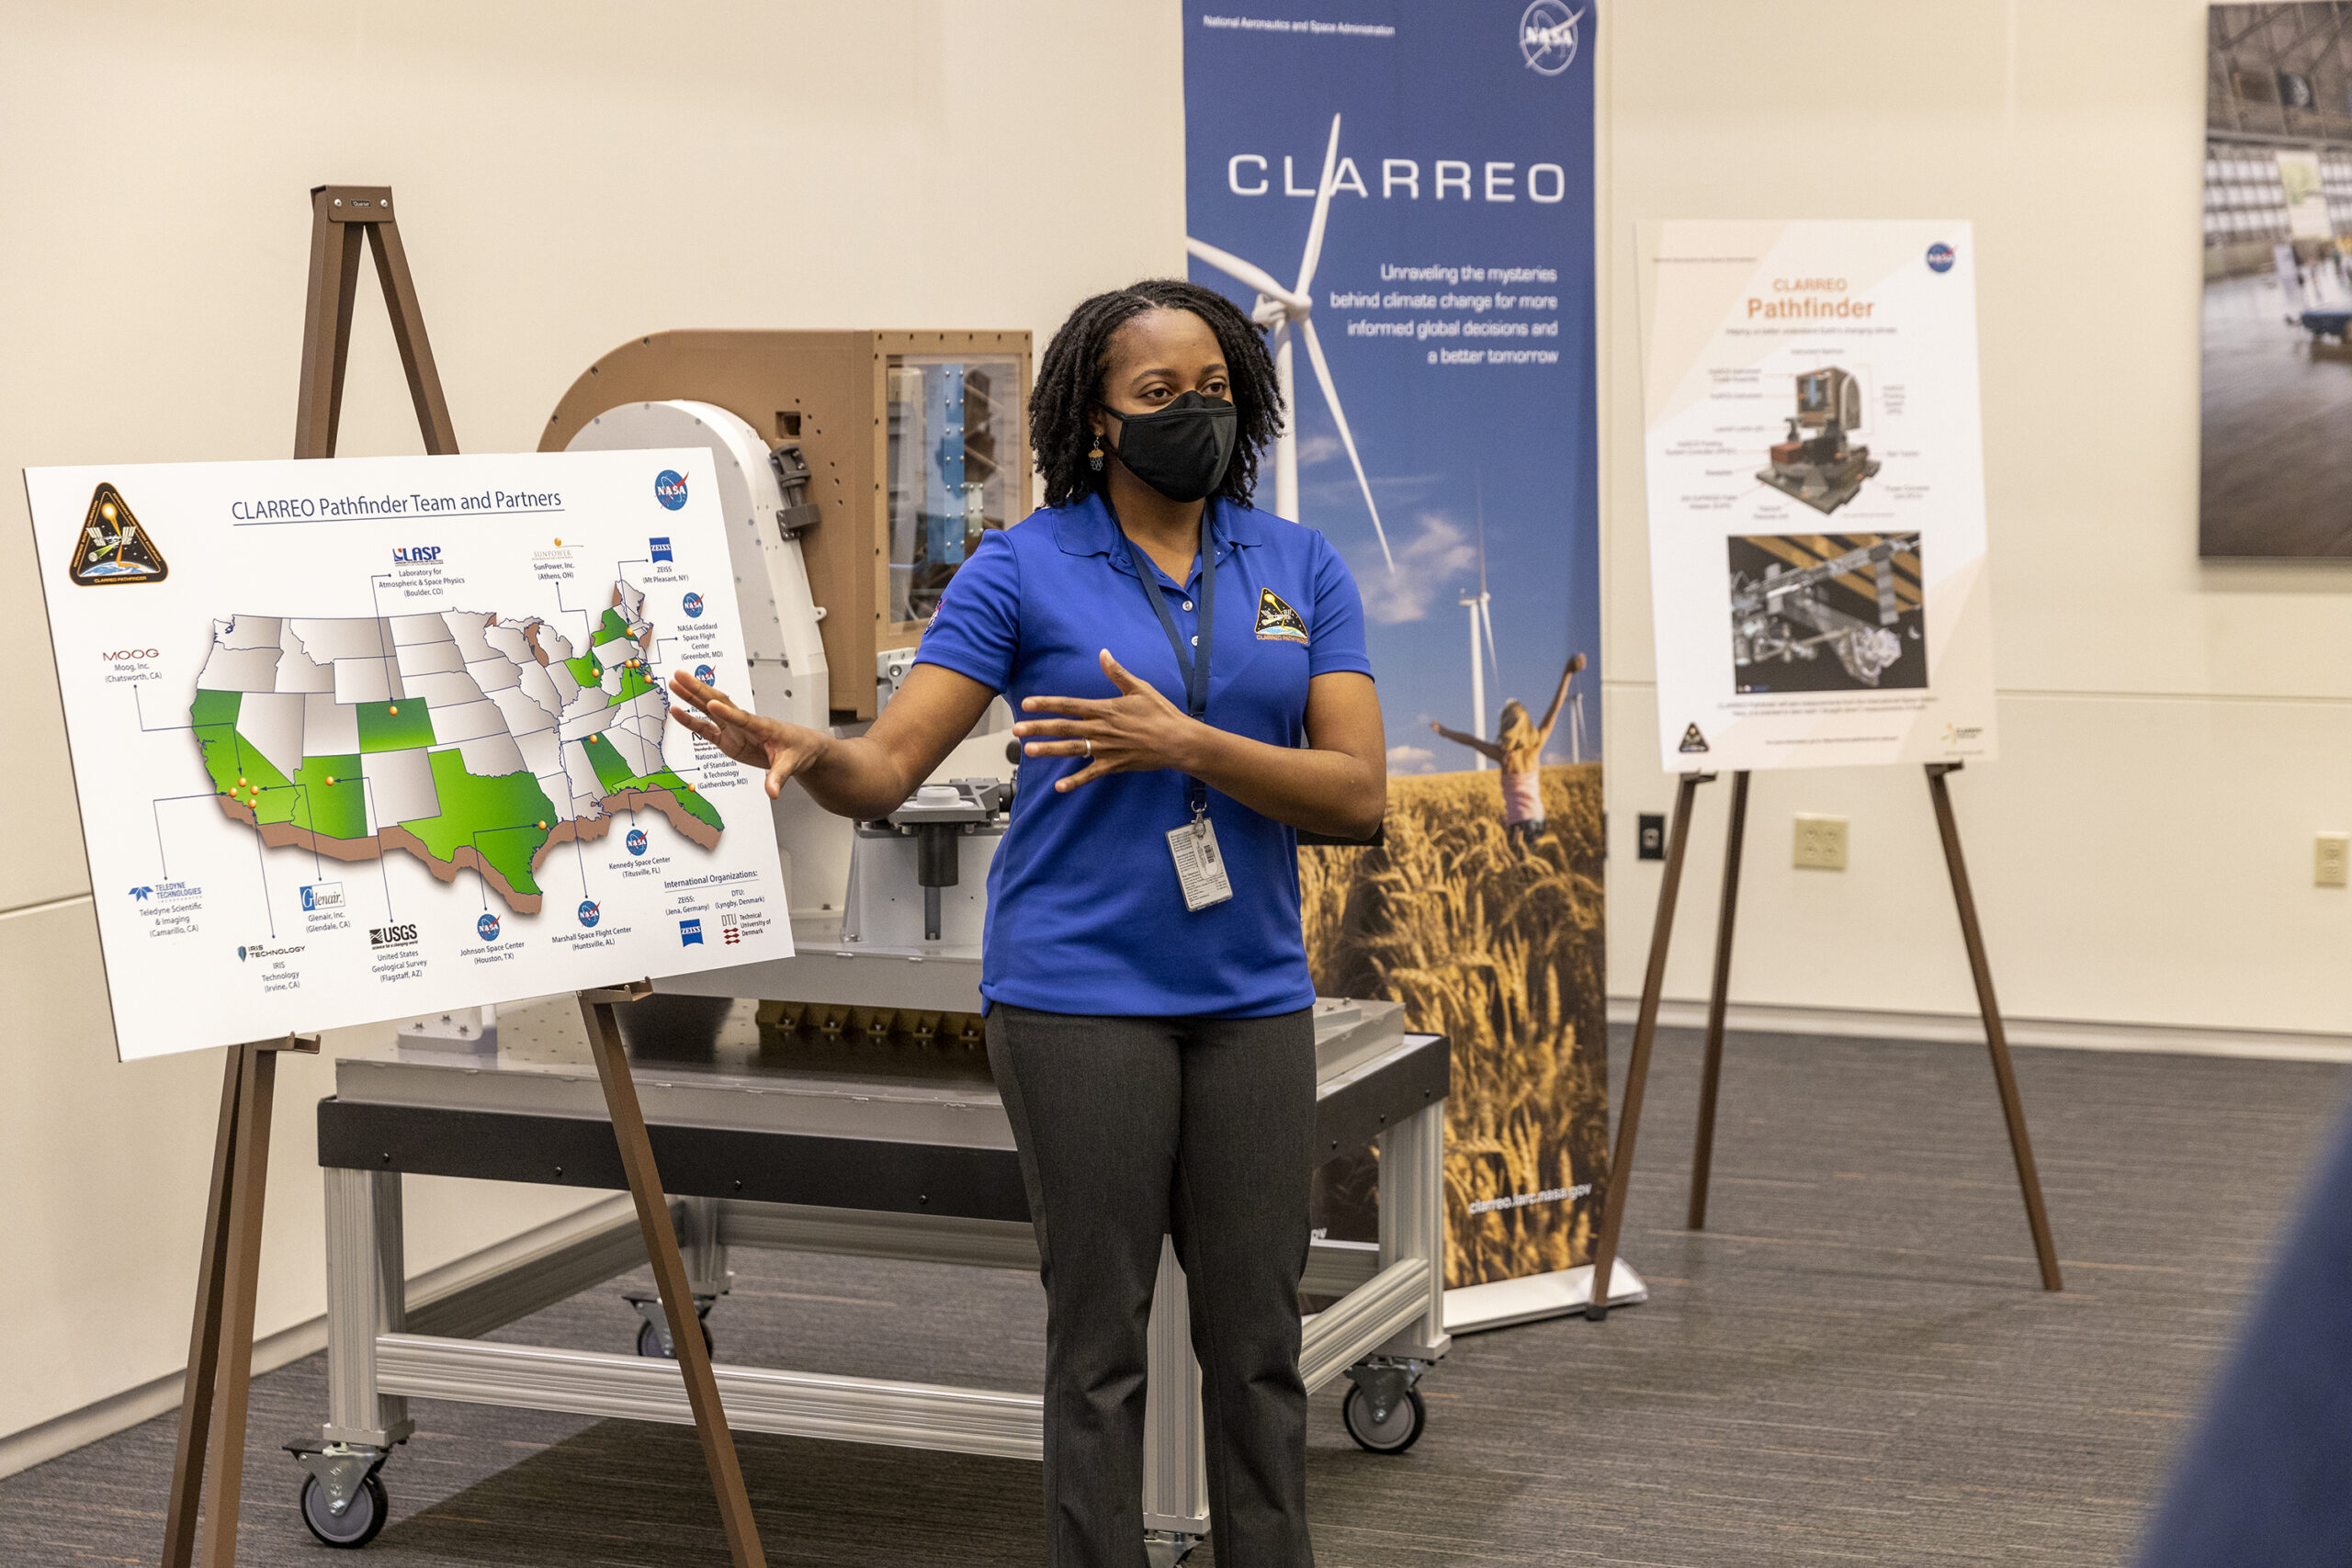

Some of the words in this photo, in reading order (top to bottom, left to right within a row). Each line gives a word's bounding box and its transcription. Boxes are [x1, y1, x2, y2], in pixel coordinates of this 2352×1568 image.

[1204, 15, 1239, 28] National
[1292, 20, 1309, 32] and
[1309, 20, 1336, 34] Space
[1227, 154, 1566, 203] CLARREO
[1381, 263, 1458, 285] Unraveling
[1461, 265, 1486, 282] the
[1487, 265, 1558, 285] mysteries
[1772, 278, 1848, 293] CLARREO
[1330, 291, 1380, 310] behind
[1383, 291, 1437, 310] climate
[1440, 292, 1493, 313] change
[1495, 292, 1517, 309] for
[1519, 296, 1558, 310] more
[1747, 298, 1875, 319] Pathfinder
[1347, 320, 1415, 337] informed
[1417, 321, 1460, 342] global
[1463, 320, 1529, 337] decisions
[1531, 321, 1559, 337] and
[1428, 351, 1438, 365] a
[1440, 348, 1486, 365] better
[1487, 348, 1559, 365] tomorrow
[657, 485, 686, 495] NASA
[232, 498, 314, 520] CLARREO
[320, 493, 408, 516] Pathfinder
[411, 493, 456, 513] Team
[460, 491, 492, 510] and
[496, 489, 561, 508] Partners
[403, 546, 441, 562] LASP
[534, 549, 571, 558] SUNPOWER
[399, 569, 432, 578] Laboratory
[424, 579, 442, 587] Space
[443, 577, 465, 585] Physics
[404, 589, 432, 597] (Boulder,
[432, 587, 444, 595] CO)
[694, 623, 718, 631] Goddard
[683, 634, 699, 642] Space
[102, 649, 160, 661] MOOG
[681, 652, 711, 660] (Greenbelt,
[114, 663, 135, 671] Moog,
[105, 673, 148, 683] (Chatsworth,
[149, 671, 163, 681] CA)
[708, 770, 740, 778] Technology
[698, 781, 736, 789] (Gaithersburg,
[609, 861, 634, 869] Kennedy
[635, 859, 651, 867] Space
[622, 869, 651, 878] (Titusville,
[664, 875, 709, 888] International
[709, 870, 758, 883] Organizations:
[155, 882, 186, 892] TELEDYNE
[156, 887, 202, 899] TECHNOLOGIES
[678, 896, 695, 904] ZEISS:
[715, 901, 739, 909] (Lyngby,
[739, 896, 765, 905] Denmark)
[140, 908, 170, 917] Teledyne
[171, 902, 202, 913] Scientific
[683, 904, 710, 913] Germany)
[162, 916, 190, 925] Imaging
[308, 913, 333, 922] Glenair,
[721, 913, 738, 927] DTU
[740, 912, 762, 920] Technical
[306, 923, 338, 933] (Glendale,
[338, 920, 351, 929] CA)
[741, 920, 765, 929] University
[150, 926, 186, 938] (Camarillo,
[187, 924, 199, 932] CA)
[383, 923, 418, 942] USGS
[552, 933, 577, 943] Marshall
[577, 931, 595, 940] Space
[595, 930, 613, 938] Flight
[613, 927, 632, 935] Center
[681, 926, 701, 935] ZEISS
[741, 928, 763, 937] Denmark
[460, 947, 486, 956] Johnson
[486, 944, 504, 953] Space
[572, 940, 605, 951] (Huntsville,
[605, 938, 616, 946] AL)
[249, 945, 306, 958] TECHNOLOGY
[378, 952, 399, 961] United
[399, 950, 419, 958] States
[273, 961, 286, 969] IRIS
[474, 955, 503, 965] (Houston,
[372, 962, 405, 973] Geological
[262, 972, 300, 982] Technology
[380, 970, 411, 983] (Flagstaff,
[412, 969, 423, 977] AZ)
[265, 983, 288, 993] (Irvine,
[288, 980, 300, 989] CA)
[1468, 1183, 1592, 1214] clarreo.larc.nasa.gov
